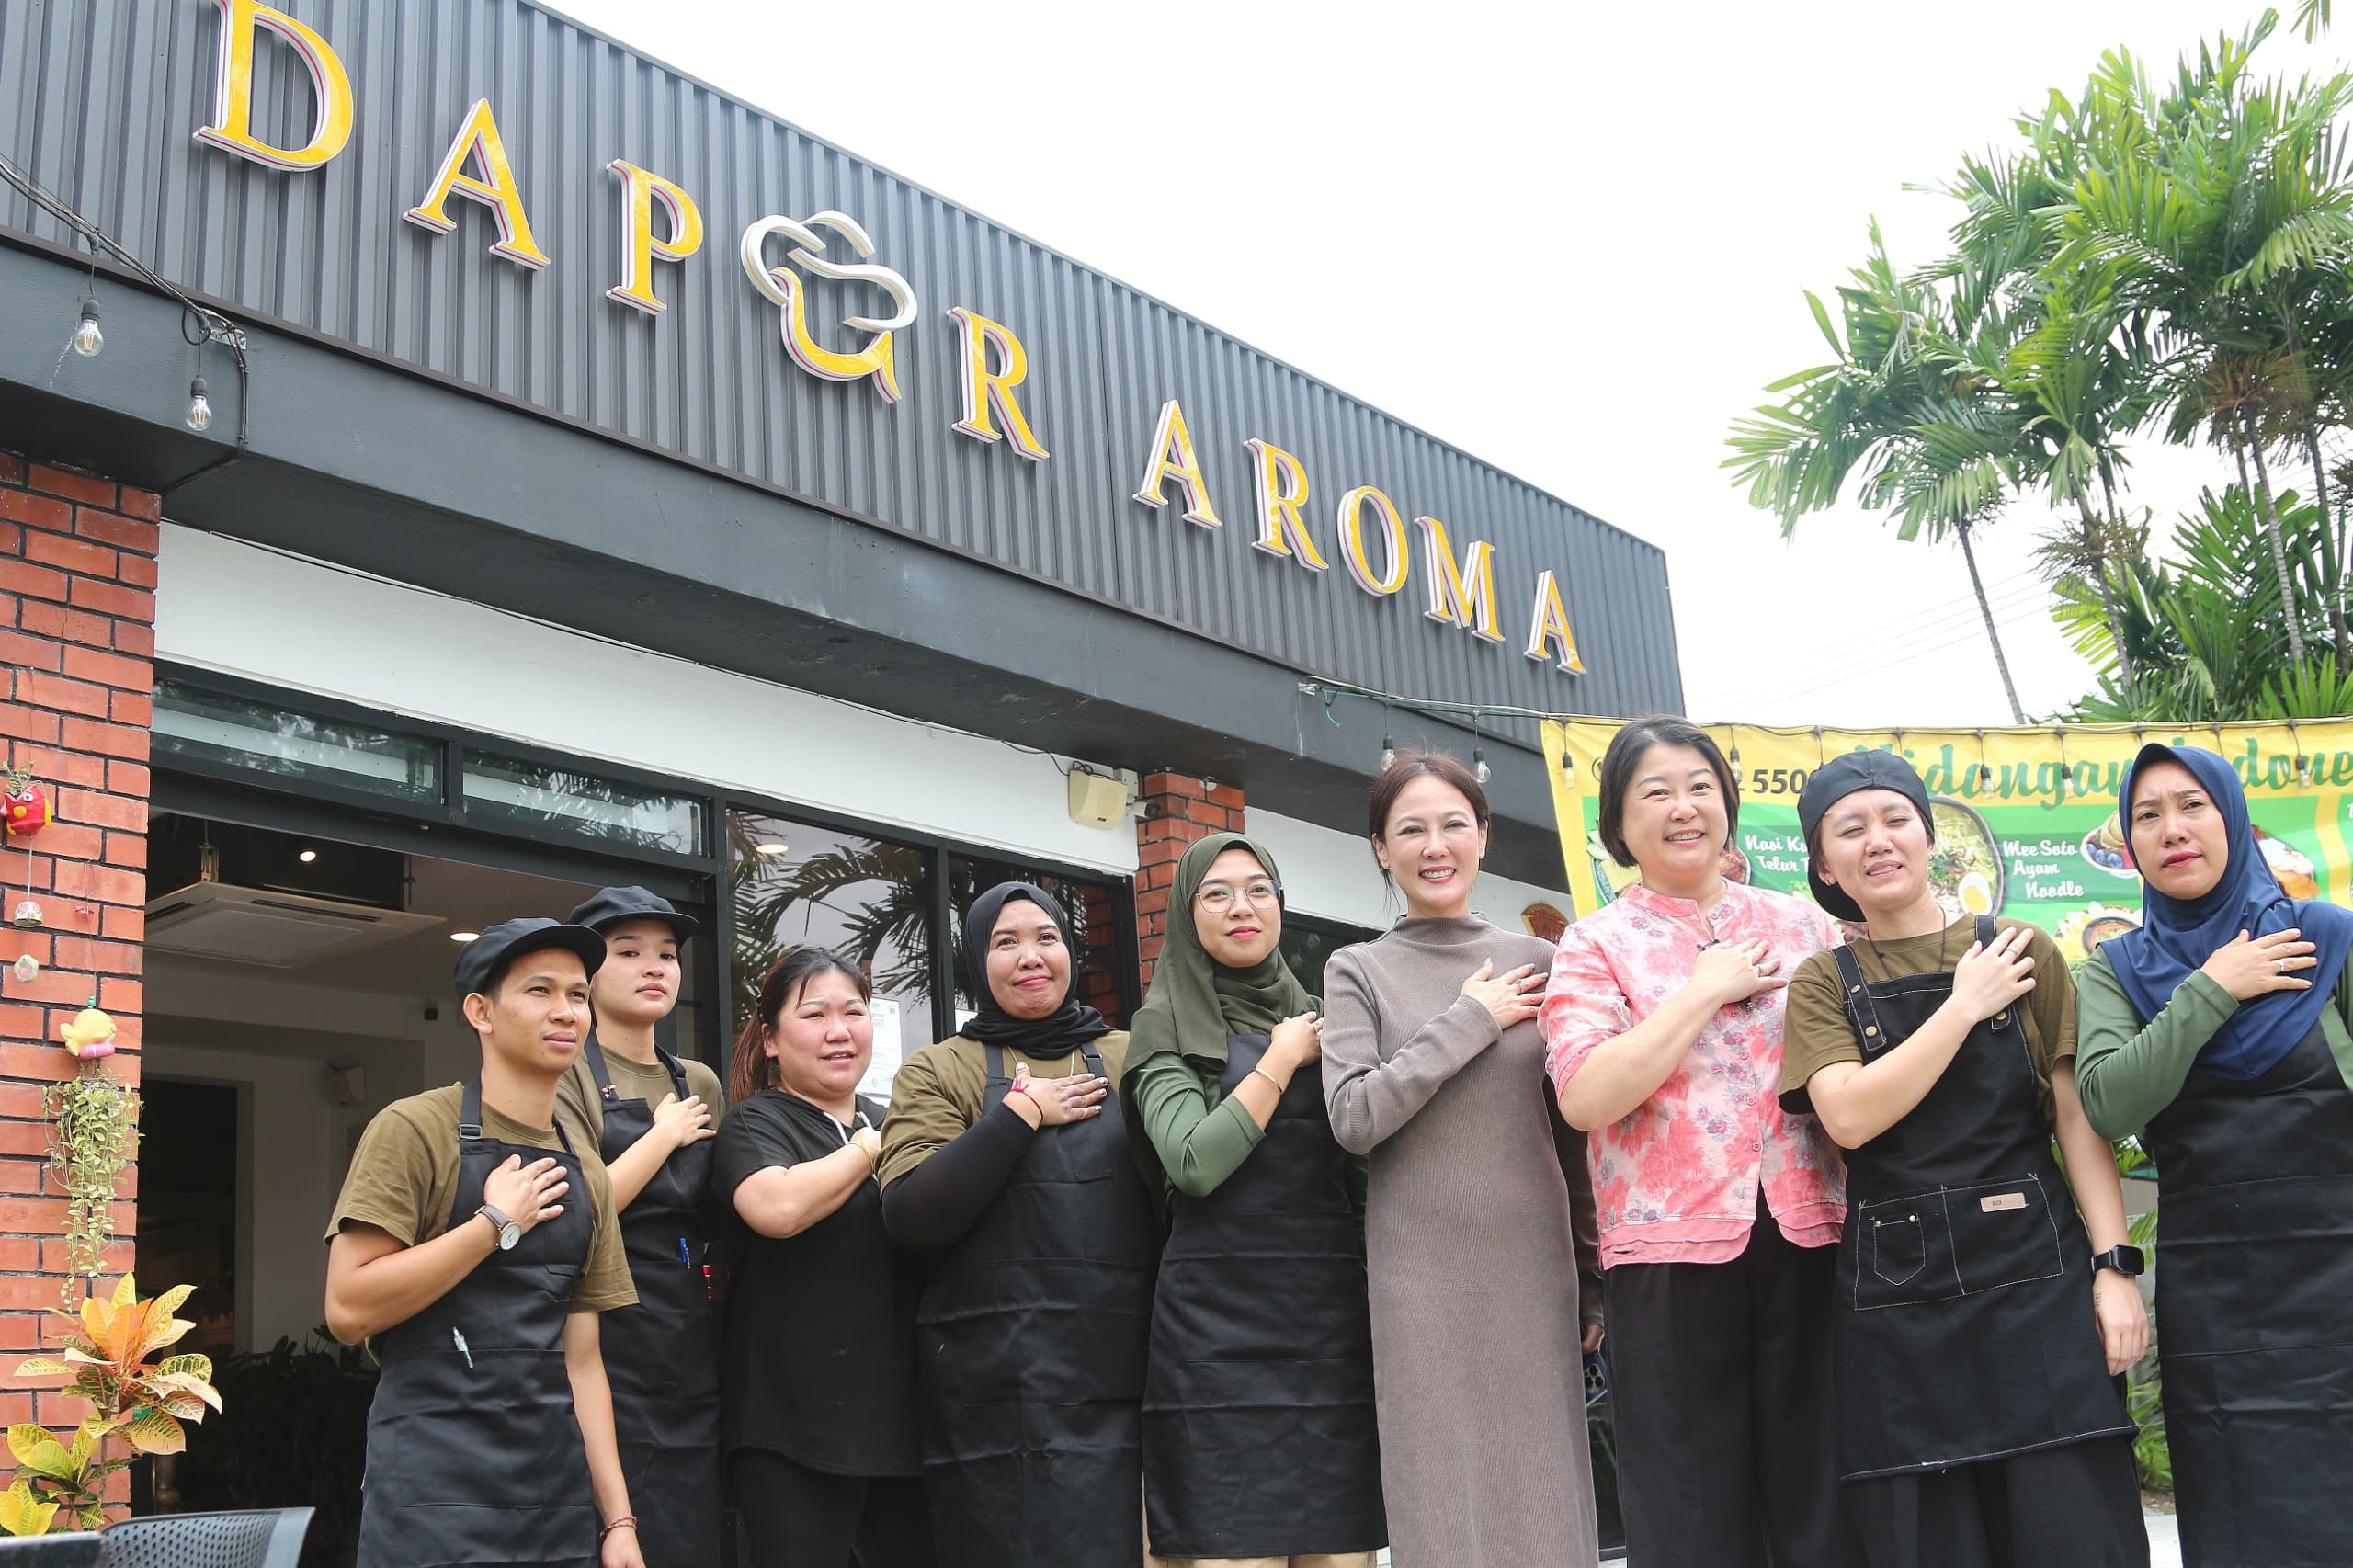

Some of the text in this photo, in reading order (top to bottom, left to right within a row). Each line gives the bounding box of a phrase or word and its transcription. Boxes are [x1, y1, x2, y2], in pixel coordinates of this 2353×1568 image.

[1132, 398, 1587, 676] AROMA
[1855, 743, 2133, 812] dangan
[1745, 834, 1784, 851] Nasi
[2003, 839, 2077, 857] Mee Soto
[1755, 855, 1800, 872] Telur
[2013, 858, 2060, 879] Ayam
[2025, 880, 2085, 899] Noodle
